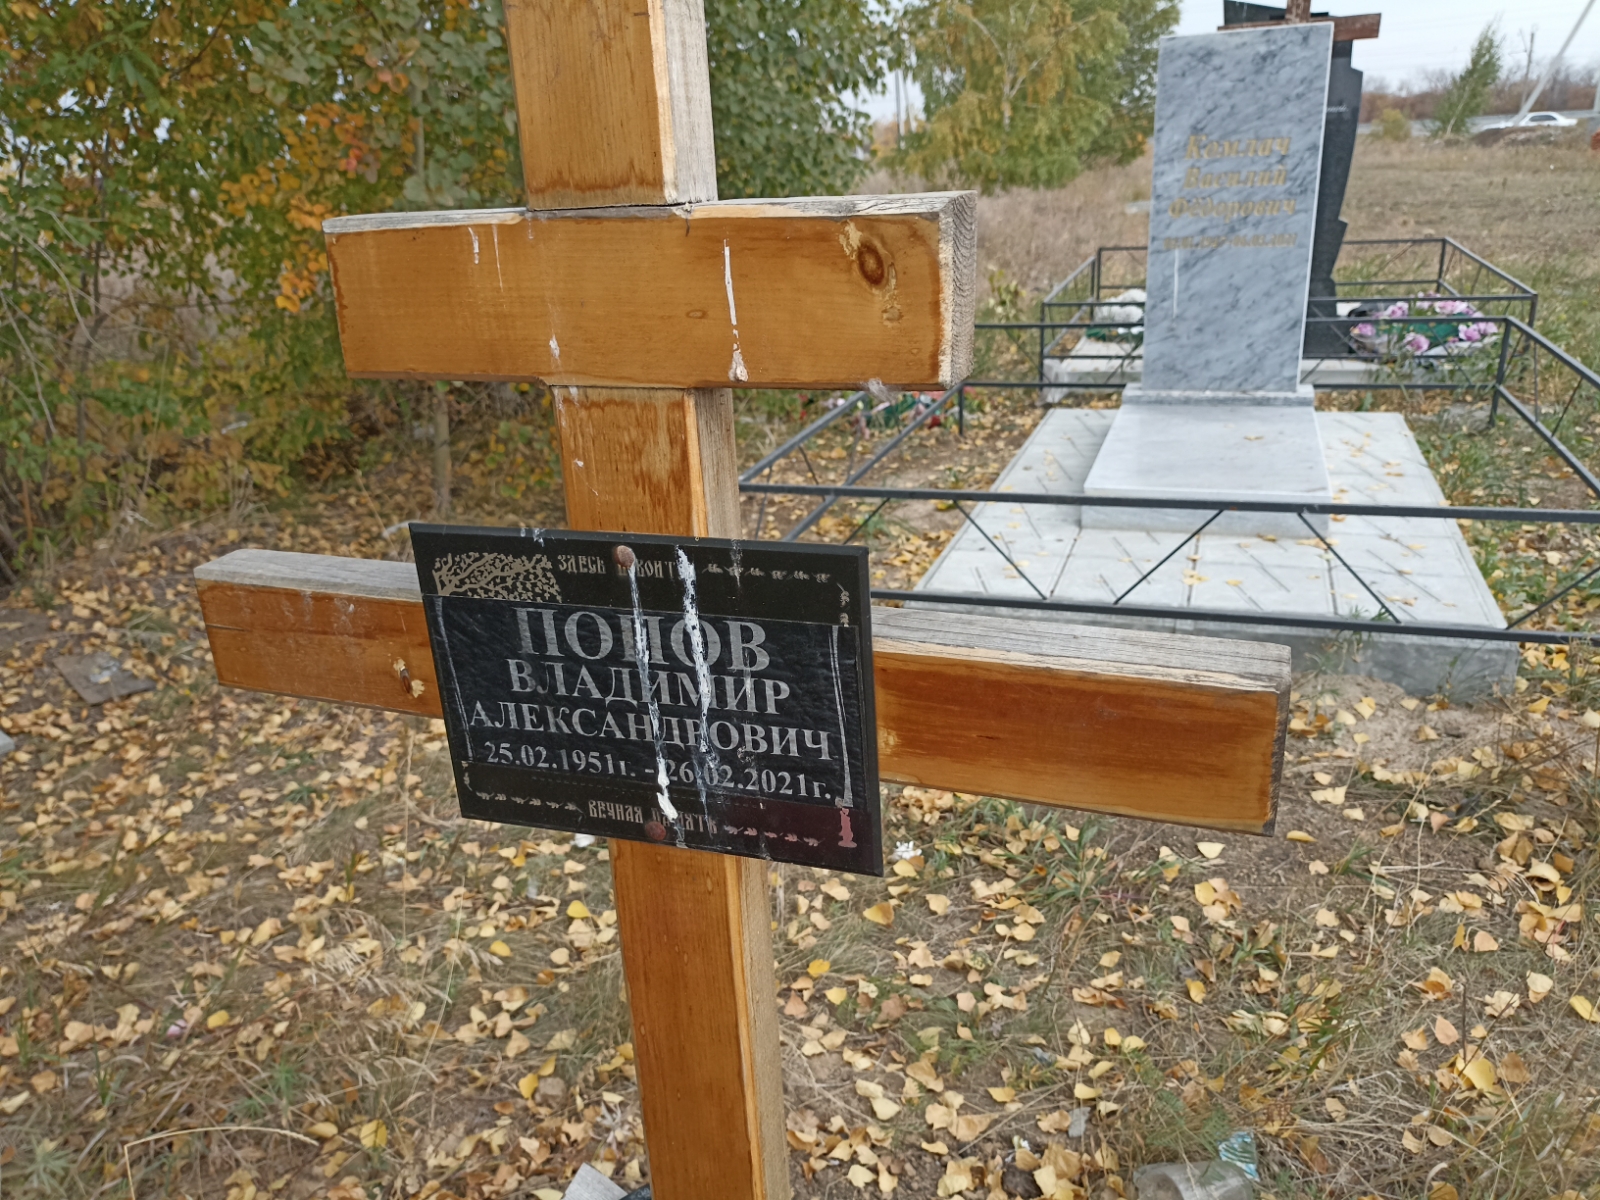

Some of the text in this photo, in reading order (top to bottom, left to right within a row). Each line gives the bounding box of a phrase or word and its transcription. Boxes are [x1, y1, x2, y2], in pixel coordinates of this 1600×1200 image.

[1183, 164, 1288, 189] Василий
[558, 555, 607, 575] ЗДЕСЬ
[511, 607, 770, 671] ПОПОВ
[504, 659, 790, 714] ВЛАДИМИР
[470, 701, 832, 761] АЛЕКСАНДРОВИЧ
[588, 800, 644, 824] ВЕЧНАЯ
